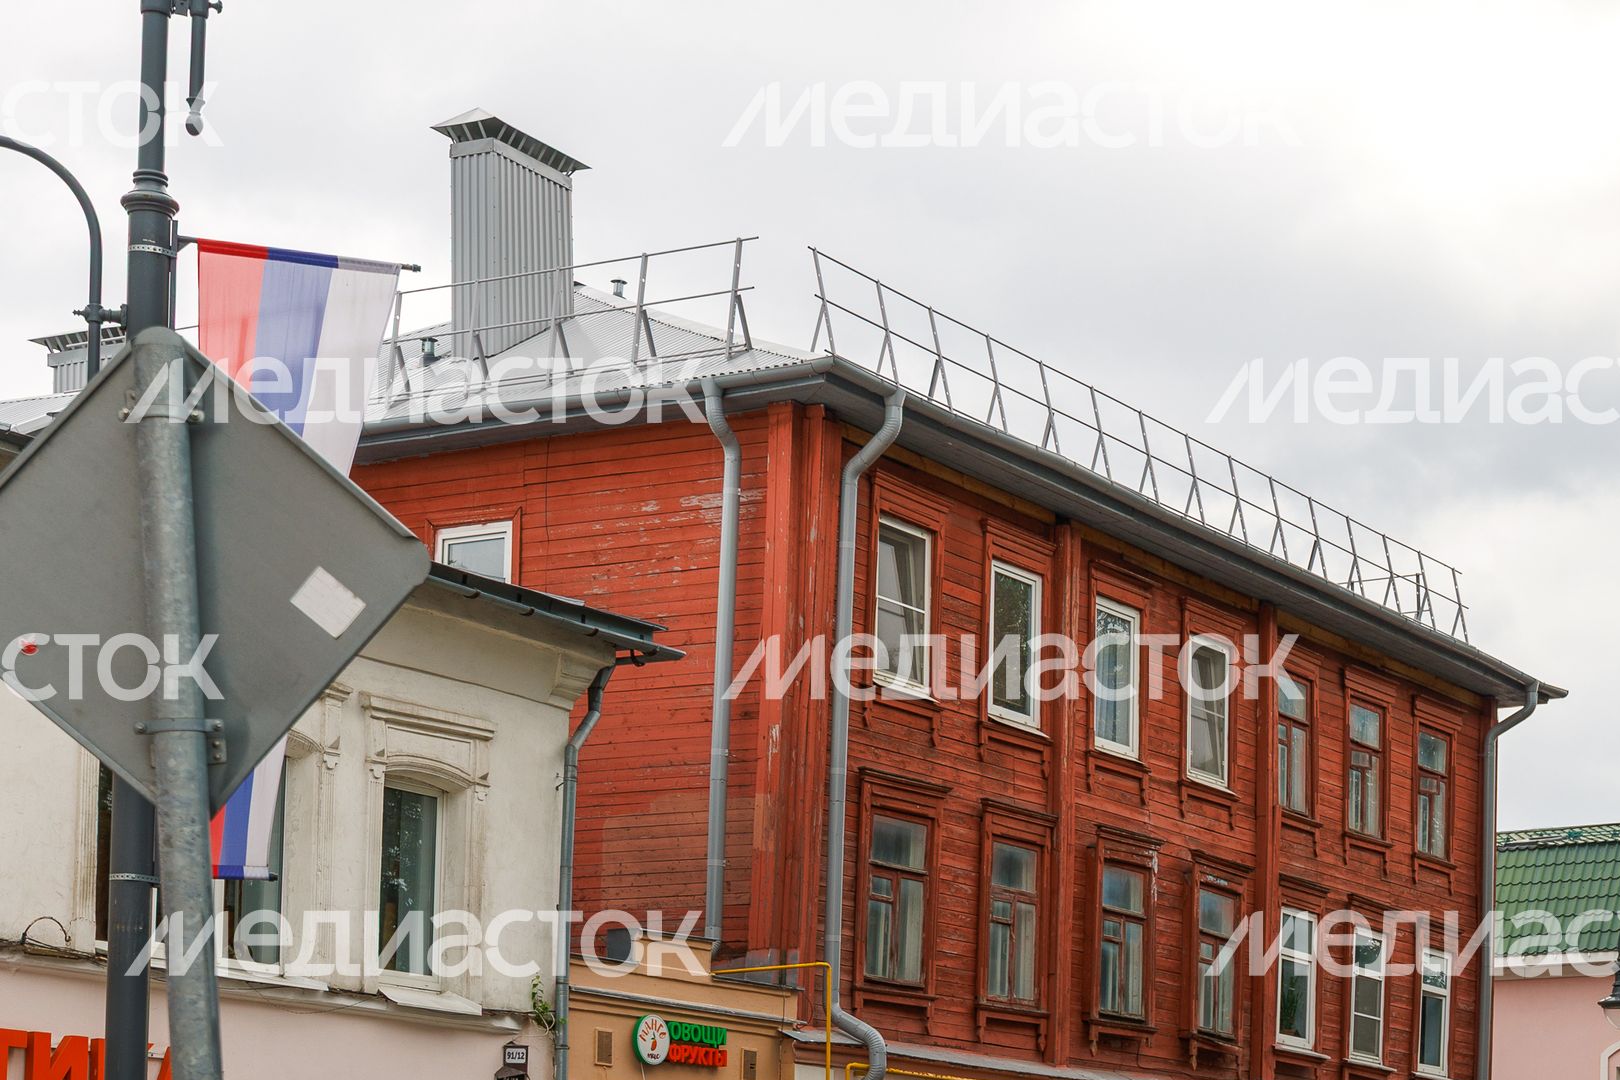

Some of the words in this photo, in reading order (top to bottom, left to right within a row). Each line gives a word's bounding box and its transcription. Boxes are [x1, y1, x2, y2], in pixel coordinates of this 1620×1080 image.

[668, 1021, 727, 1048] ОВОЩИ
[506, 1051, 525, 1060] 91/12
[668, 1043, 727, 1067] ФРУКТЫ
